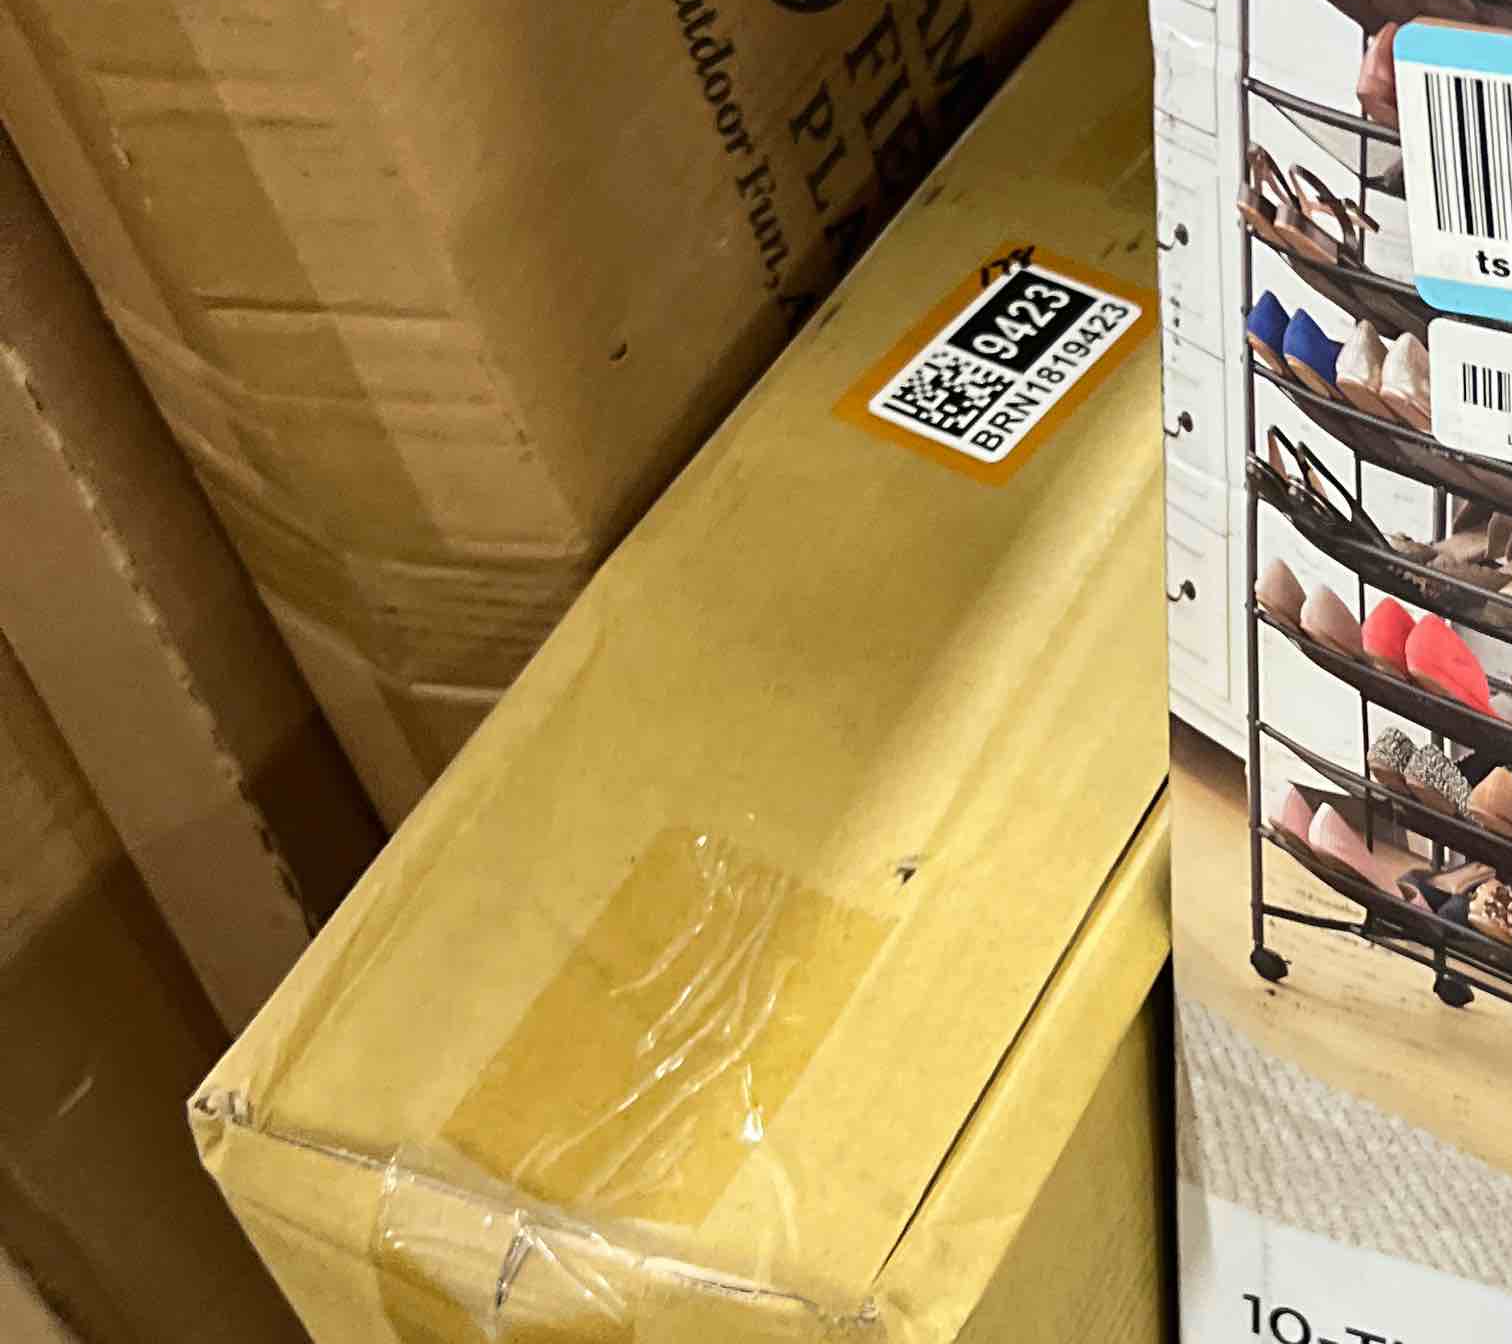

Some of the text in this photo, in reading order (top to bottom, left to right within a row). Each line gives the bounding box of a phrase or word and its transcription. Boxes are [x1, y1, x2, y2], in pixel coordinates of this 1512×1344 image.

[736, 155, 791, 290] Fun,
[969, 301, 1130, 453] BRN1819423
[972, 283, 1071, 360] 9423
